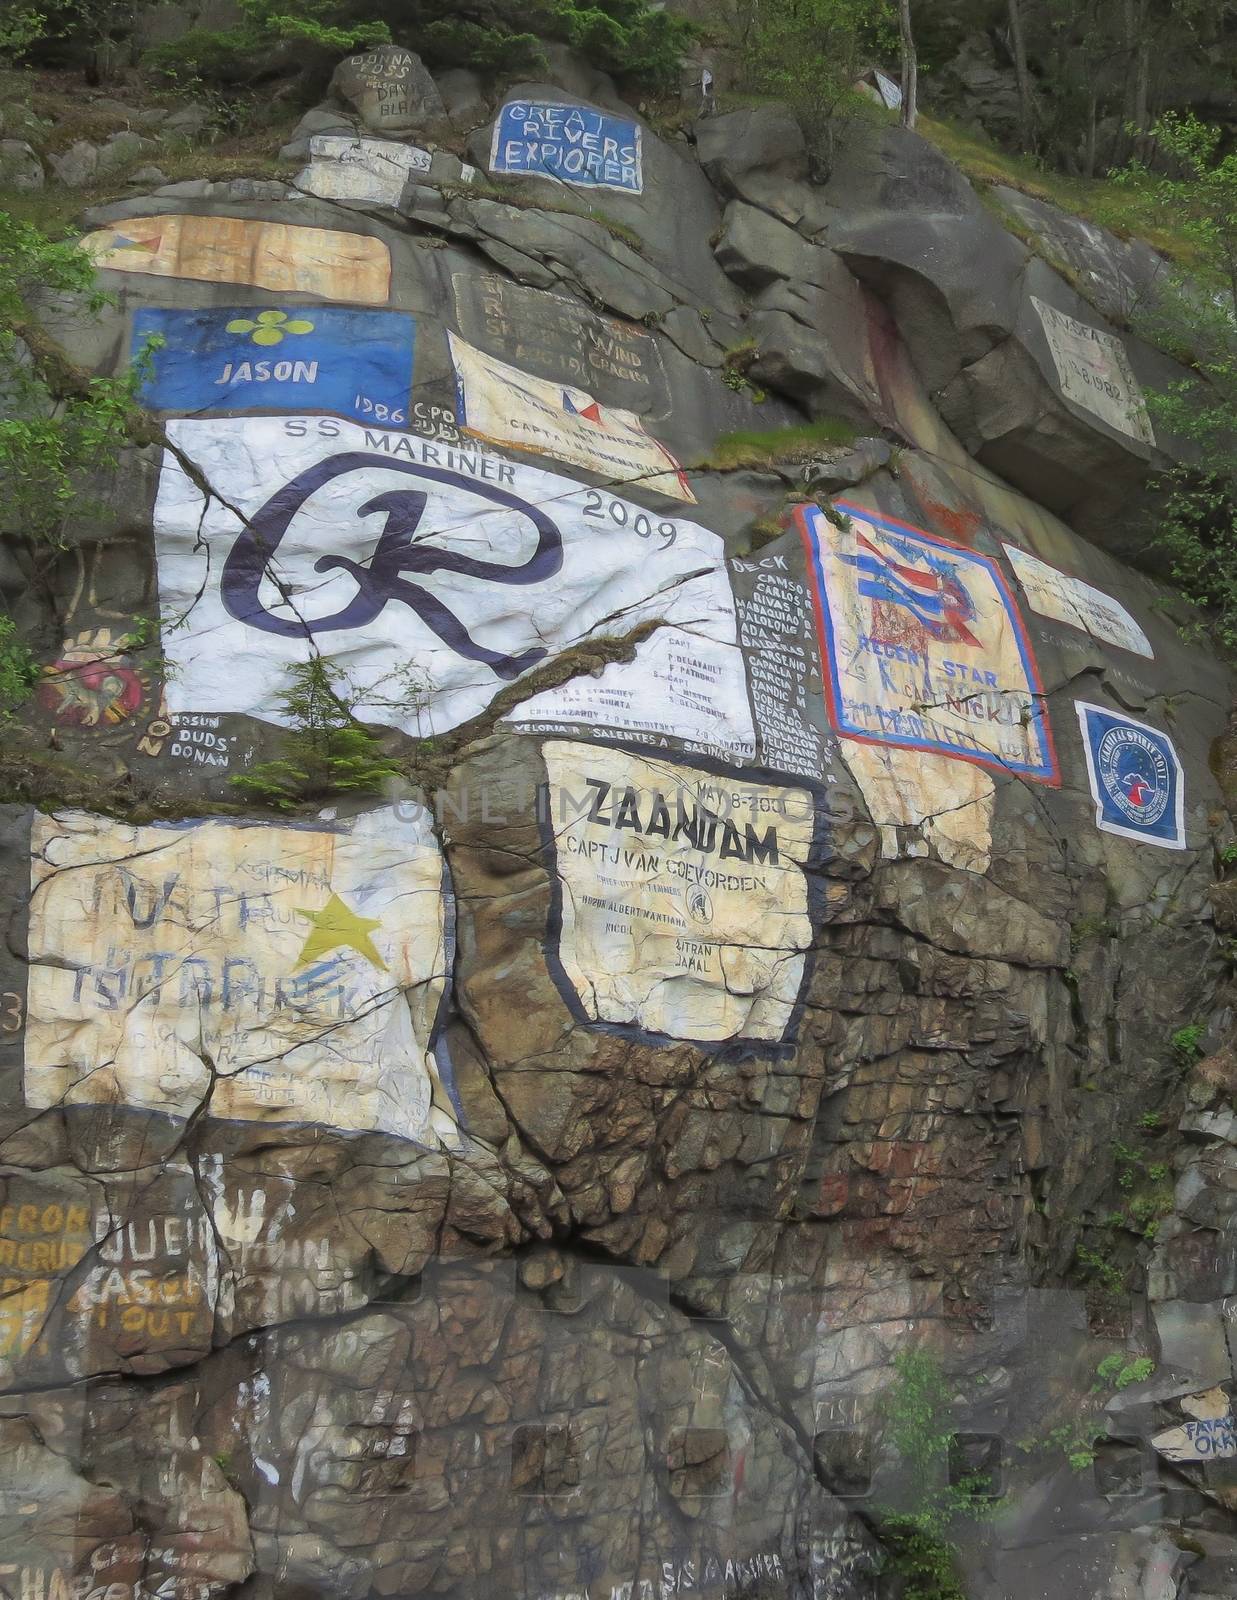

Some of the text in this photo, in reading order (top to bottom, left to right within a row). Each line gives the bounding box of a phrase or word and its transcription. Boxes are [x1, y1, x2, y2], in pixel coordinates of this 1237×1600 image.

[509, 105, 604, 134] GREAT
[523, 121, 635, 165] RIVERS
[214, 361, 319, 385] JASON
[355, 393, 405, 424] 1986
[510, 419, 583, 450] CAPTAIN
[364, 431, 516, 485] MARINER
[583, 490, 677, 552] 2009
[730, 555, 788, 573] DECK
[753, 592, 791, 612] RIVAS
[756, 583, 801, 606] CARLOS
[760, 650, 806, 673] ARSENIO
[942, 660, 998, 688] STAR
[750, 679, 790, 702] JANDIC
[751, 666, 792, 691] GARCIA
[171, 743, 229, 767] DONAN
[515, 724, 568, 733] VELORIA
[593, 728, 657, 745] SALENTES
[659, 737, 669, 748] A
[735, 758, 745, 769] J
[760, 732, 818, 761] FELICIANO
[762, 745, 815, 769] USARAGA
[1153, 753, 1168, 779] 2011
[698, 781, 724, 805] MAY
[586, 777, 779, 866] ZAANDAM
[566, 836, 609, 863] CAPT
[624, 852, 661, 873] VAN
[666, 859, 767, 892] COEVORDEN
[608, 901, 641, 917] ALBERT
